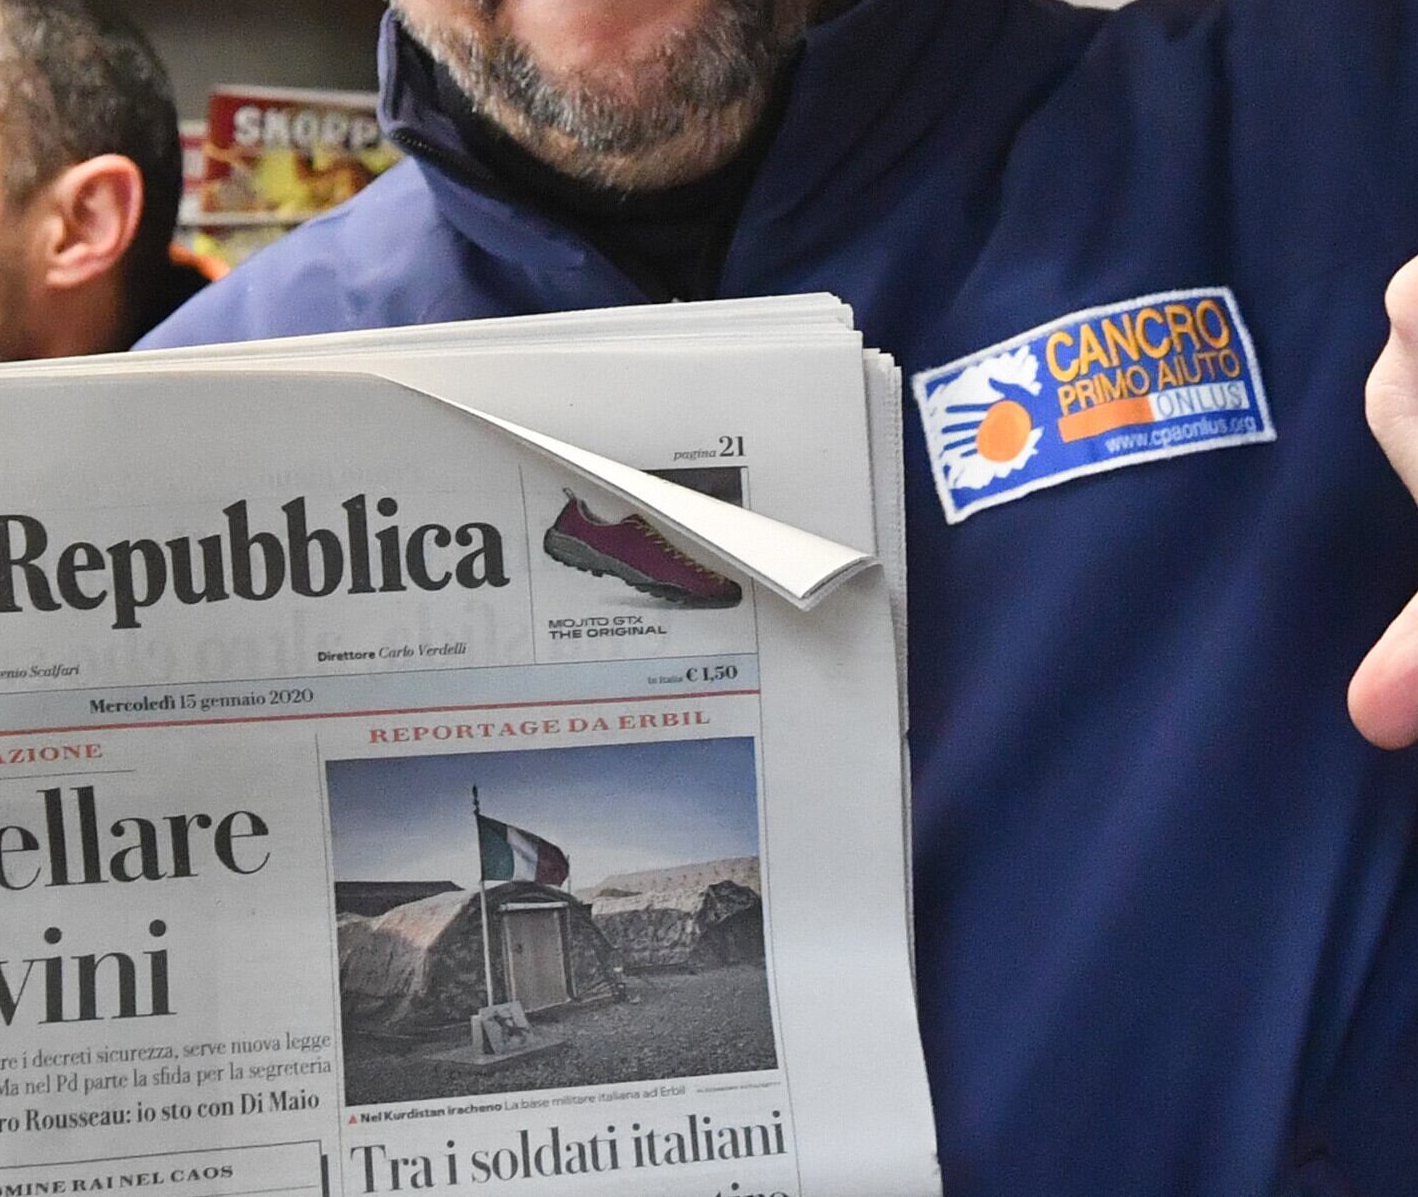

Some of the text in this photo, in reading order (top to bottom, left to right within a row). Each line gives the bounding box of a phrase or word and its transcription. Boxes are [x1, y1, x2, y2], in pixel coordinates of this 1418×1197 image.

[1046, 299, 1231, 383] CANCRO
[1058, 349, 1242, 416] PRIMO AIUTO
[1156, 382, 1245, 419] ONLUS
[673, 435, 747, 462] pagina 21
[1106, 415, 1257, 454] www.cpaonlus.org
[548, 615, 644, 630] MOJITO GTX
[549, 625, 668, 641] THE ORIGINAL
[318, 642, 468, 663] Direttore Carlo Verdelli
[29, 662, 80, 681] Scalfari
[702, 665, 739, 683] 1,50
[89, 688, 315, 715] Mercoledì 15 gennaio 2020
[368, 707, 712, 747] REPORTAGE DA ERBIL
[32, 1047, 92, 1069] decreti
[95, 1043, 179, 1065] sicurezza,
[183, 1042, 227, 1059] serve
[231, 1037, 281, 1055] nuova
[286, 1031, 332, 1052] legge
[25, 1074, 51, 1095] nel
[56, 1070, 79, 1093] Pd
[84, 1074, 128, 1096] parte
[133, 1068, 148, 1088] la
[152, 1064, 192, 1087] sfida
[196, 1067, 225, 1087] per
[230, 1061, 245, 1081] la
[249, 1057, 332, 1081] segreteria
[25, 1107, 132, 1133] Rousseau:
[136, 1102, 156, 1124] io
[161, 1101, 192, 1122] sto
[196, 1100, 234, 1118] con
[240, 1093, 264, 1116] Di
[269, 1089, 320, 1112] Maio
[360, 1111, 383, 1125] Nel
[383, 1106, 446, 1122] Kurdistan
[447, 1102, 503, 1118] iracheno
[504, 1097, 520, 1111] La
[521, 1096, 549, 1109] base
[552, 1091, 596, 1106] militare
[598, 1088, 640, 1103] italiana
[643, 1087, 658, 1100] ad
[660, 1084, 686, 1099] Erbil
[351, 1110, 789, 1195] Tra i soldati italiani
[72, 1174, 113, 1192] RAI
[119, 1171, 165, 1189] NEL
[170, 1165, 234, 1183] CAOS
